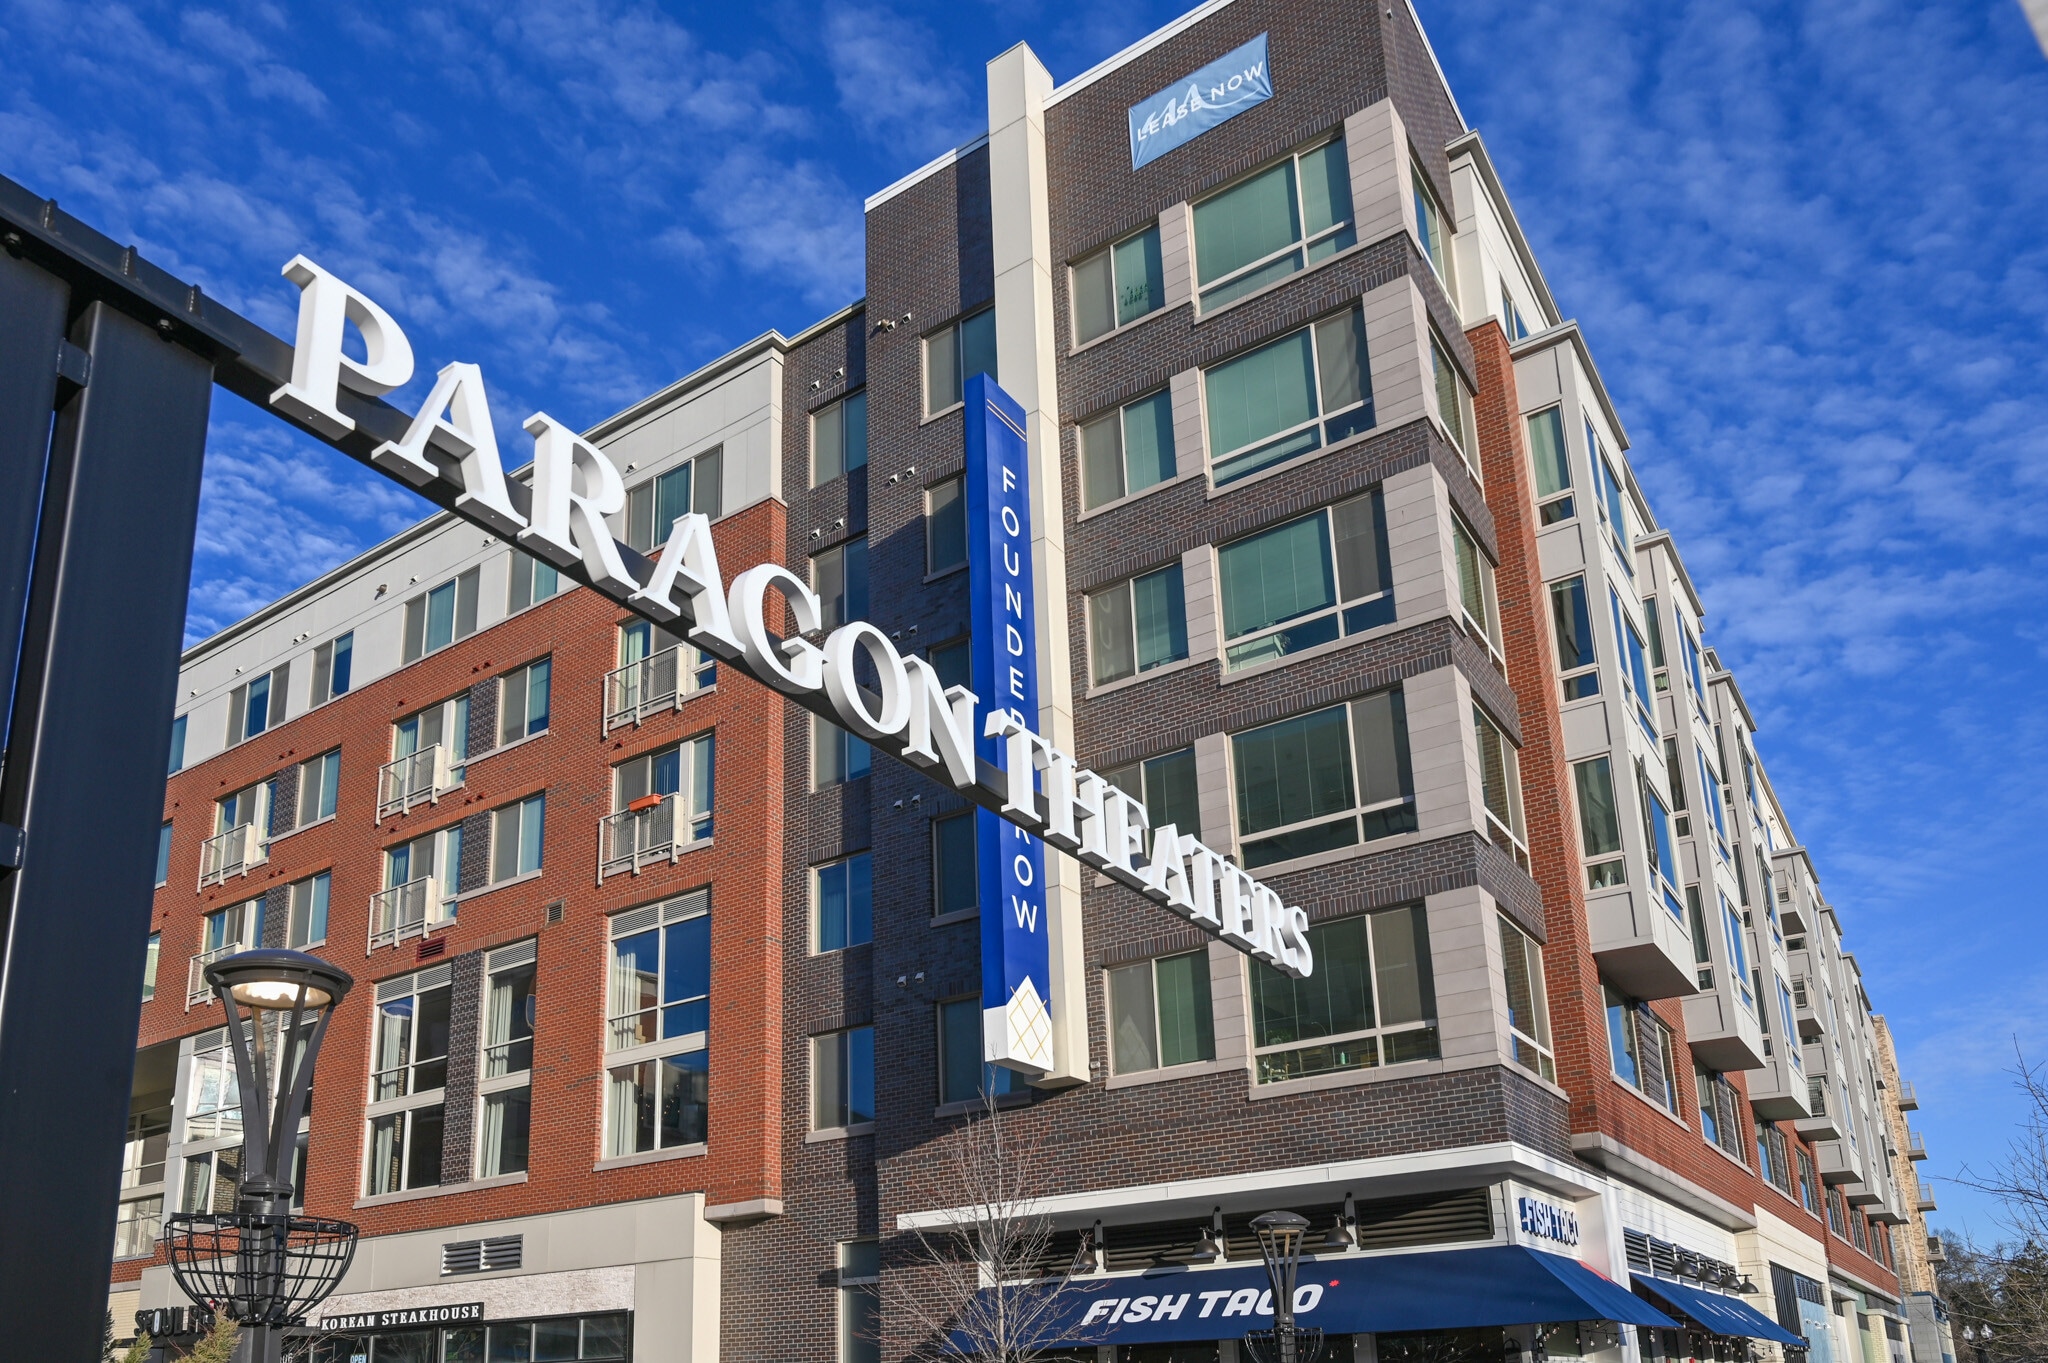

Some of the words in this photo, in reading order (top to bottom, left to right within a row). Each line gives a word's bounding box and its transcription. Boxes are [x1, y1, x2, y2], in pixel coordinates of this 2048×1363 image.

[1138, 98, 1203, 141] LEASE
[1211, 61, 1263, 101] NOW
[269, 253, 980, 788] PARAGON
[984, 708, 1313, 978] THEATERS
[1002, 465, 1026, 728] FOUNDE
[1519, 1197, 1553, 1237] FISH
[1550, 1206, 1580, 1246] TACO
[321, 1315, 375, 1331] KOREAN
[382, 1305, 480, 1326] STEAKHOUSE
[1081, 1293, 1191, 1325] FISH
[1198, 1283, 1324, 1318] TACO
[350, 1355, 367, 1363] OPEN
